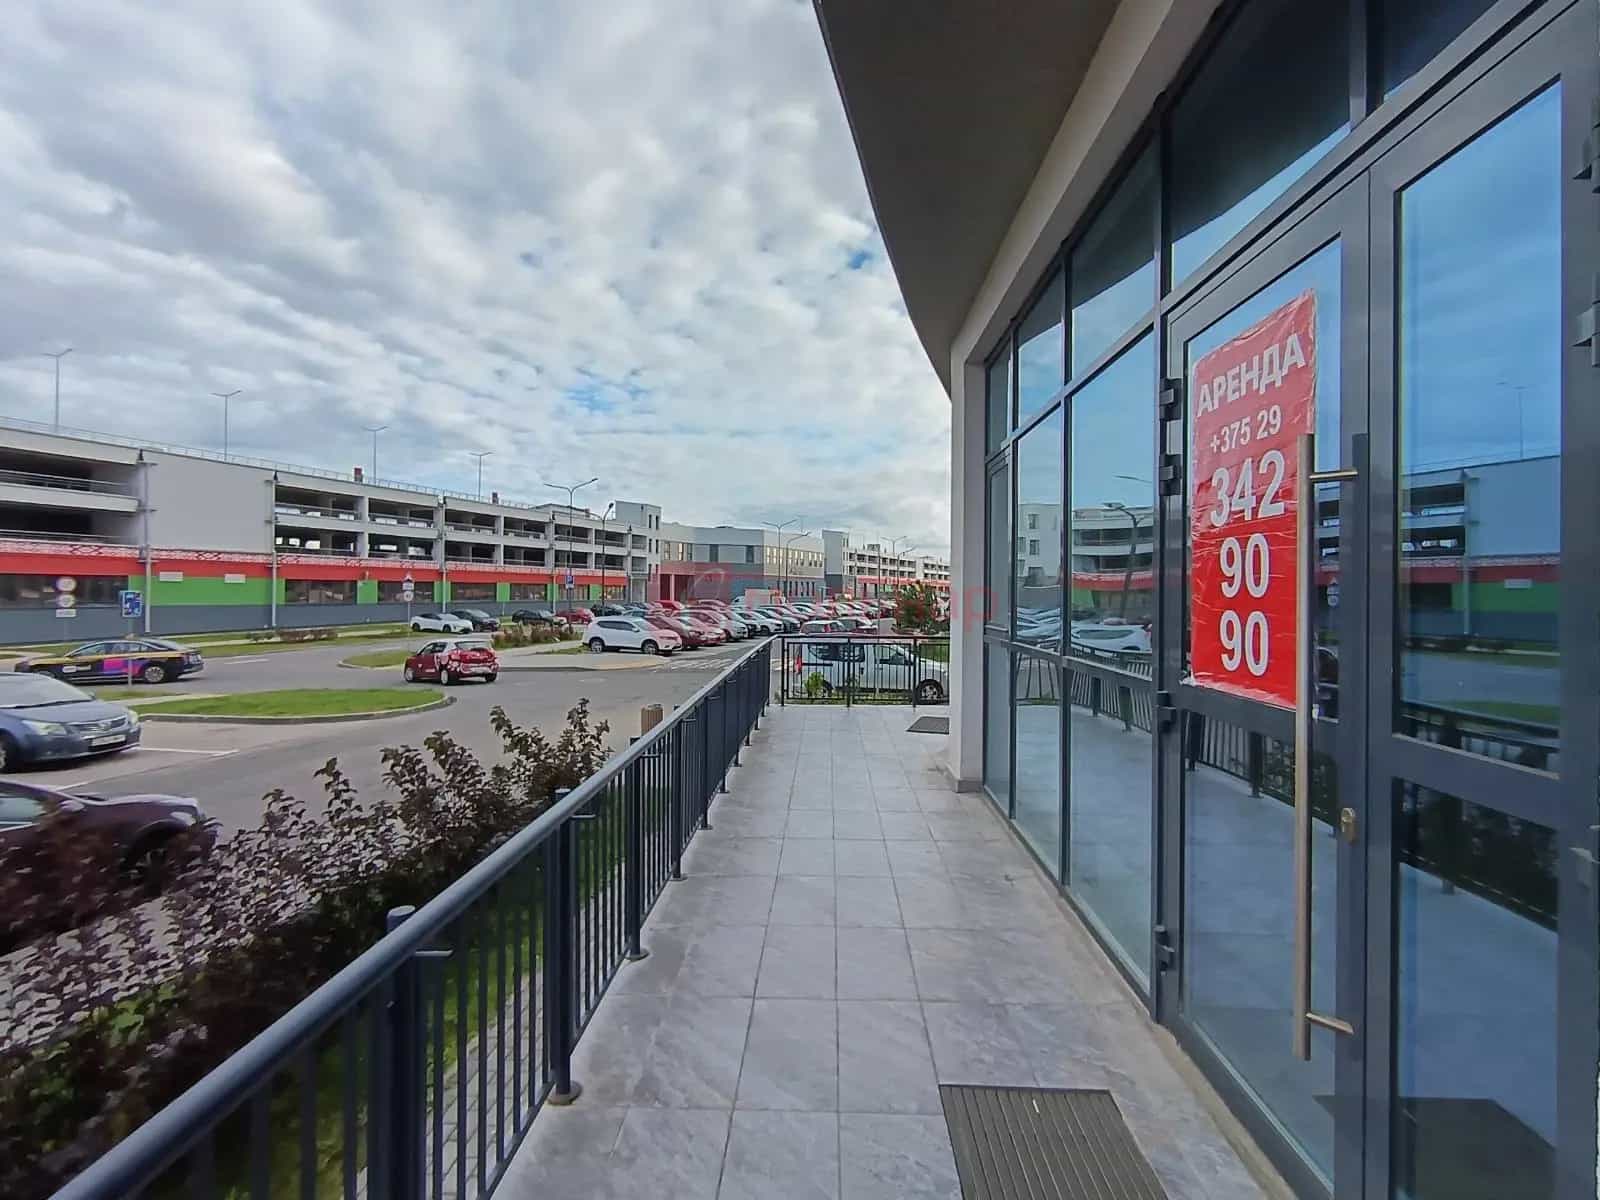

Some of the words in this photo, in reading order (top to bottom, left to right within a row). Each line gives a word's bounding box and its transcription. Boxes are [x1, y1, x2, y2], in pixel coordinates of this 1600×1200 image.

[1197, 333, 1305, 417] АРЕНДА
[1210, 422, 1251, 454] +375
[1256, 404, 1281, 438] 29
[1210, 450, 1285, 528] 342
[1220, 533, 1270, 598] 90
[1220, 610, 1270, 676] 90
